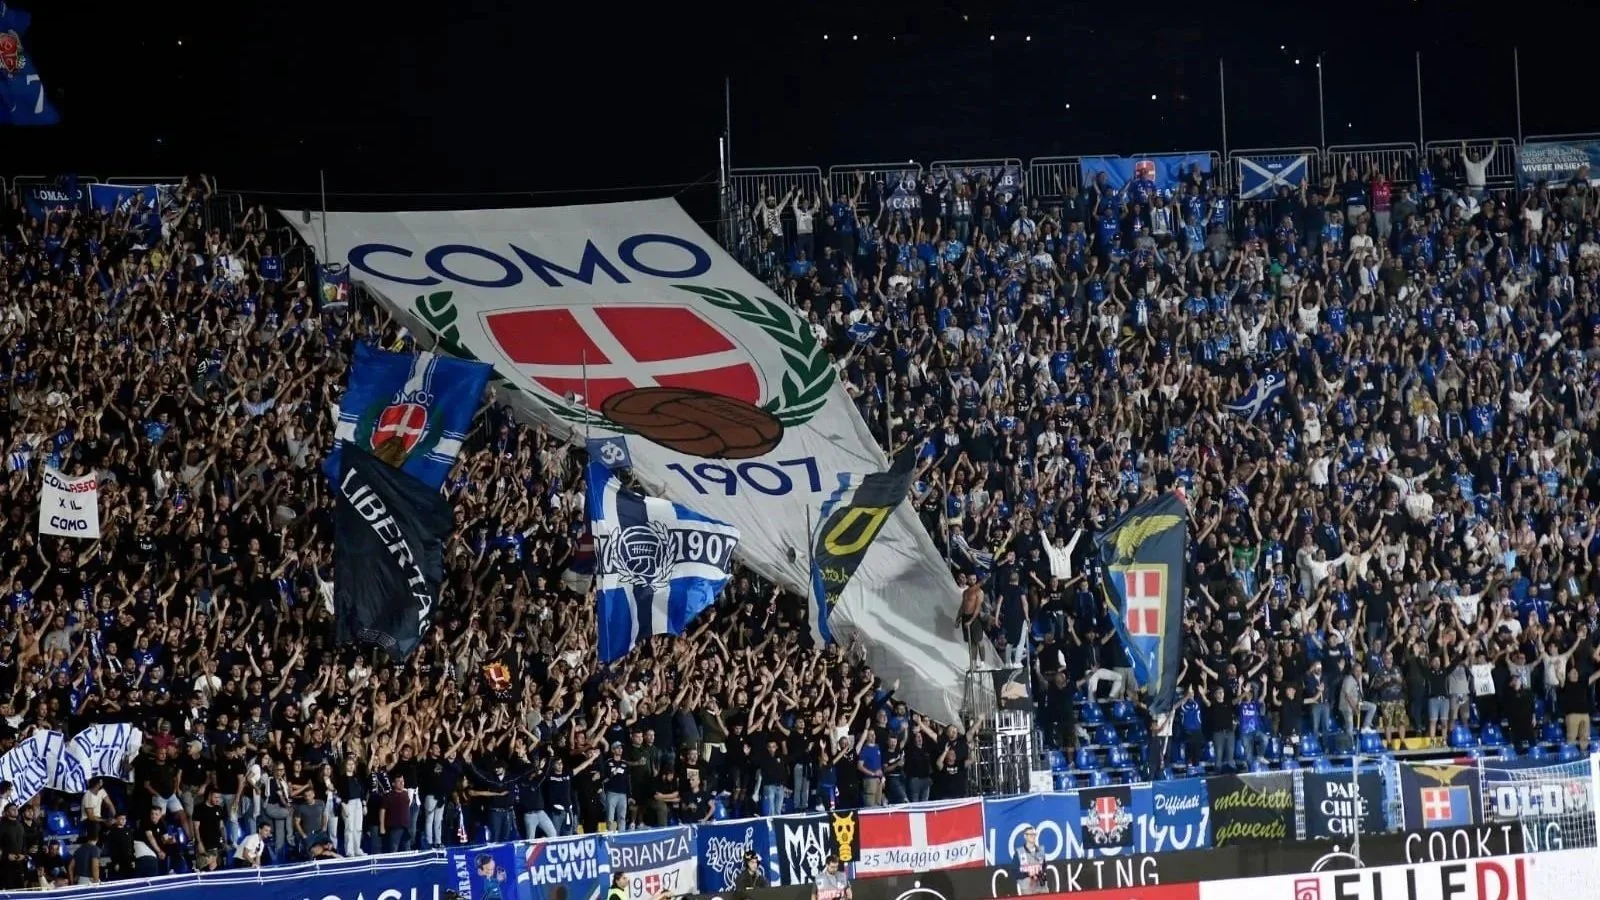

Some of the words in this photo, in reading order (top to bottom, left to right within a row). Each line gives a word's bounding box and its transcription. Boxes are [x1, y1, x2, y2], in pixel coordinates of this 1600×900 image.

[1522, 164, 1552, 172] VIVERE
[347, 233, 712, 288] COMO
[44, 472, 97, 493] COLLASSO
[665, 456, 822, 496] 1907
[59, 497, 66, 509] X
[70, 500, 82, 511] IL
[50, 515, 88, 531] COMO
[675, 531, 737, 571] 1907
[1154, 793, 1200, 817] Diffidati
[1216, 815, 1287, 846] gioventù
[1405, 821, 1563, 864] COOKING
[546, 838, 596, 863] COMO
[610, 836, 689, 868] BRIANZA
[864, 854, 881, 868] 25
[884, 850, 940, 868] Maggio
[945, 844, 977, 861] 1907
[530, 858, 598, 886] MCMVII
